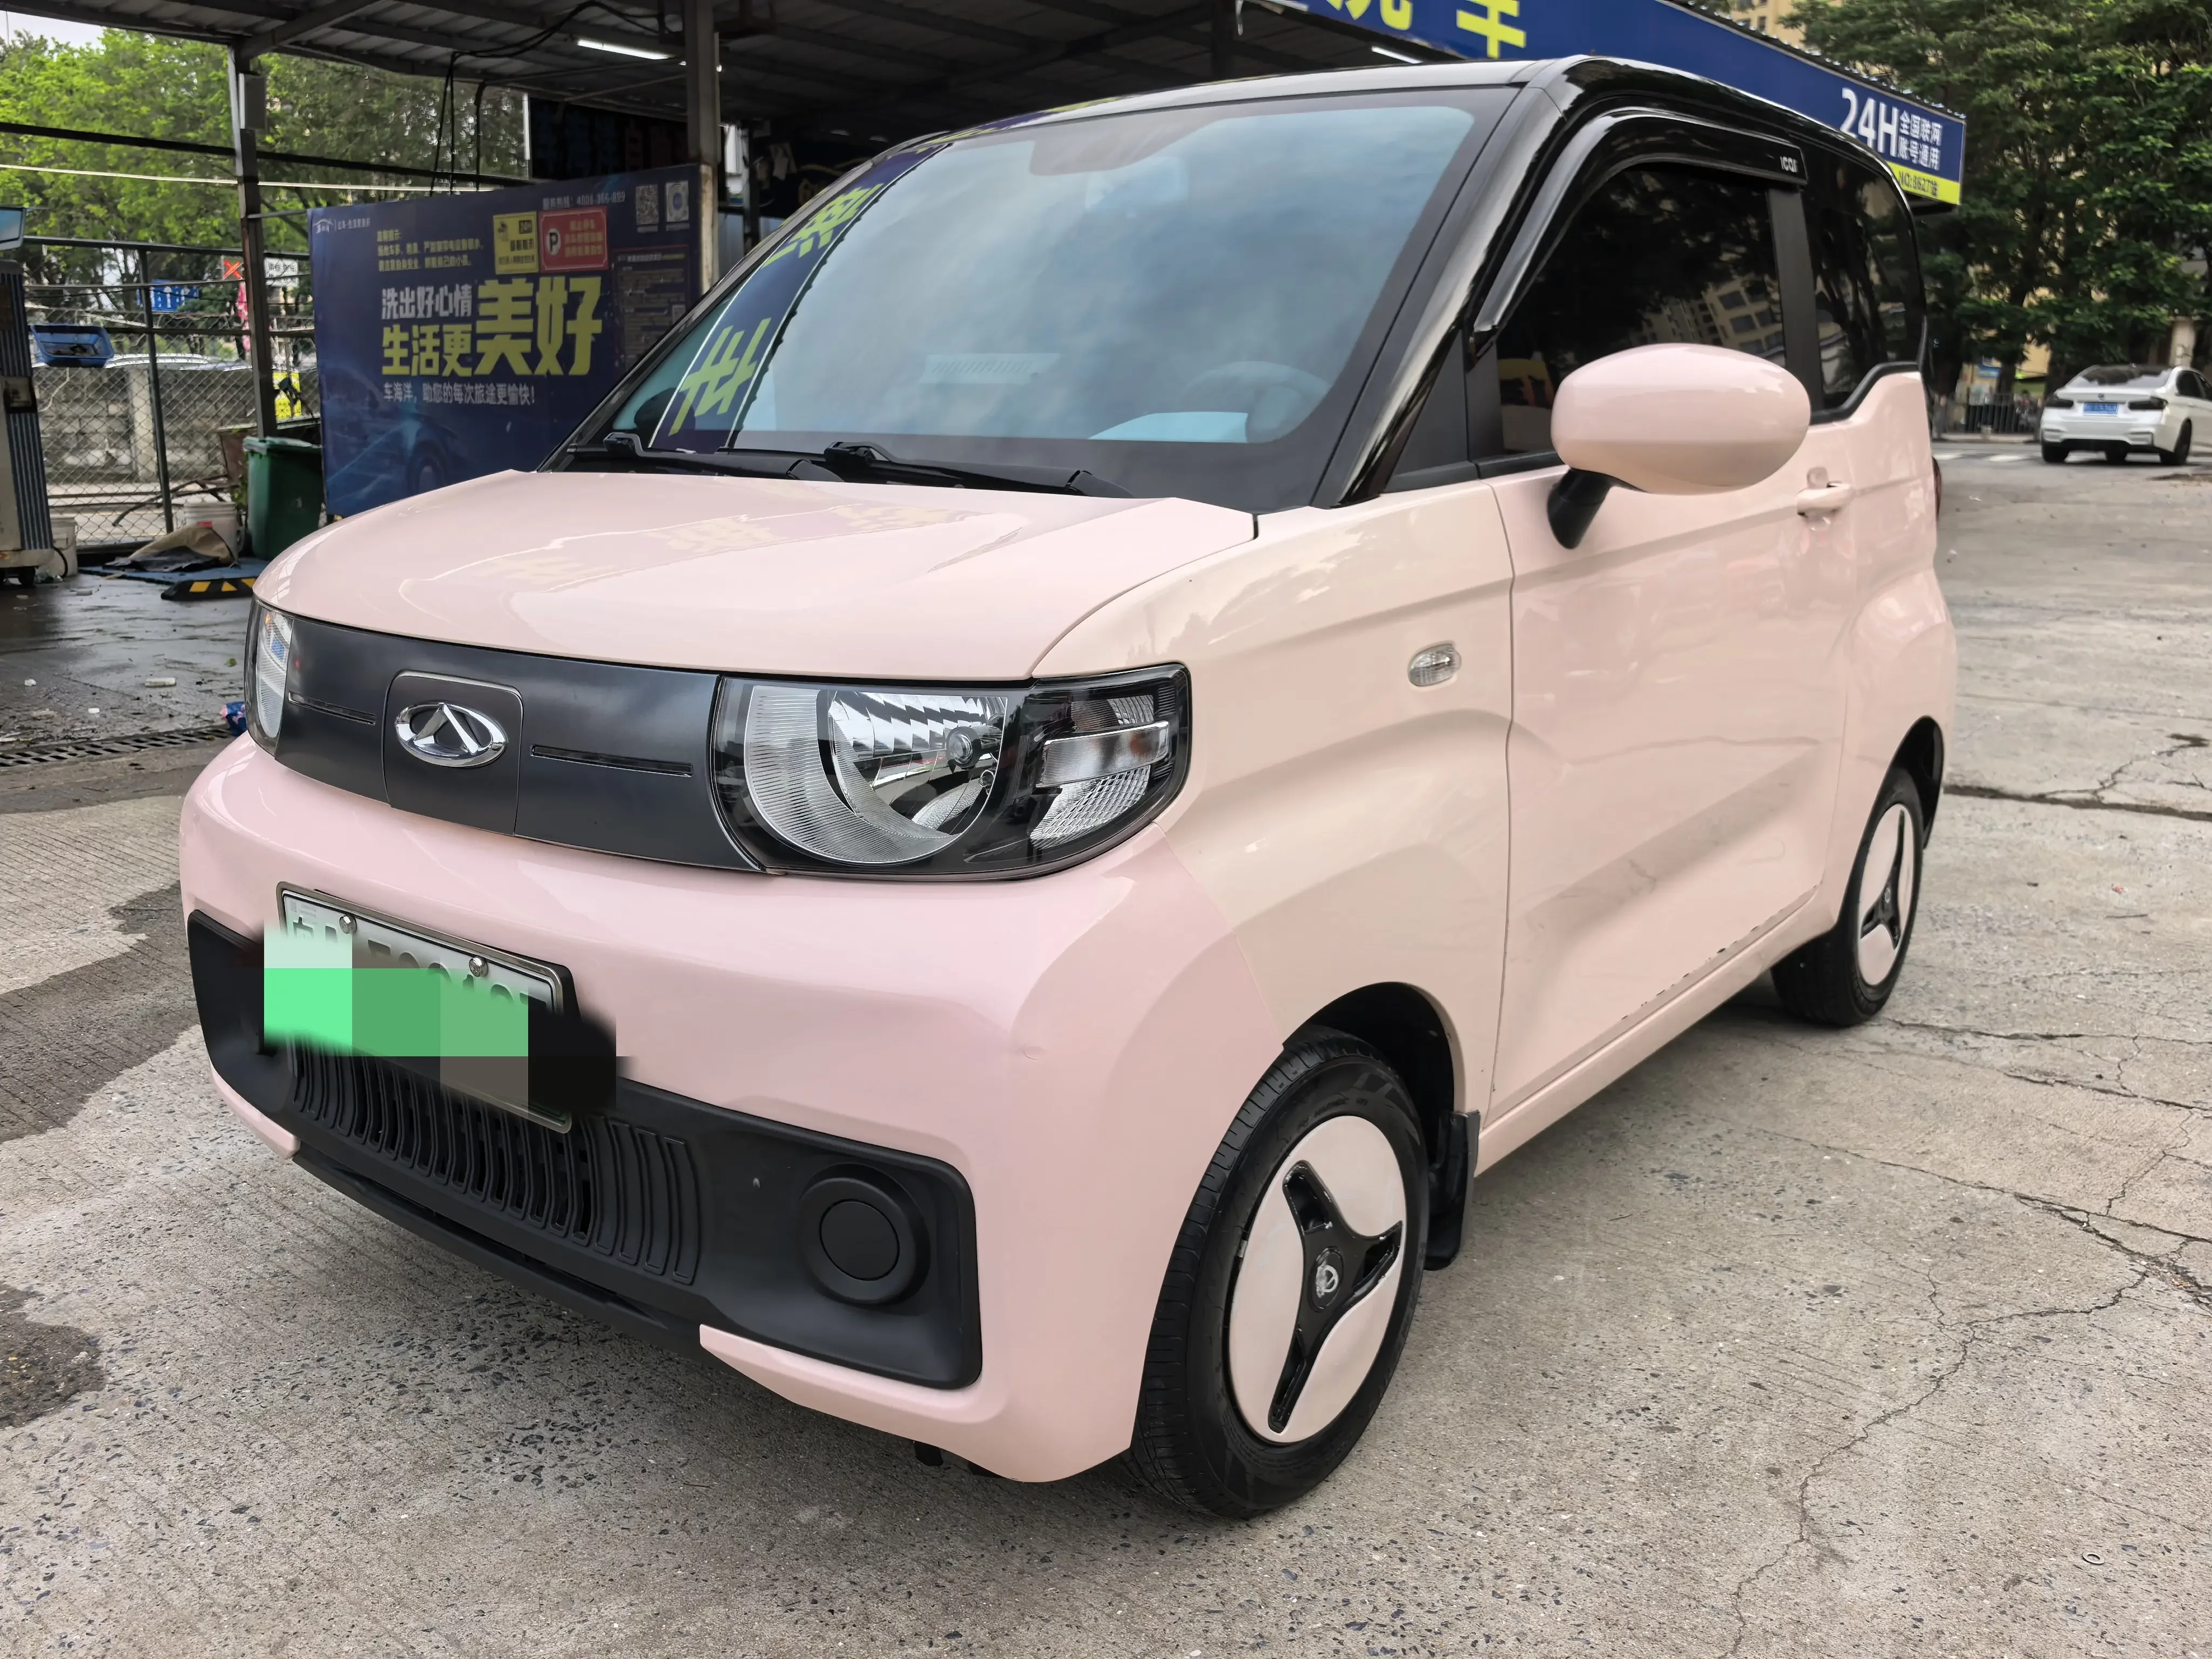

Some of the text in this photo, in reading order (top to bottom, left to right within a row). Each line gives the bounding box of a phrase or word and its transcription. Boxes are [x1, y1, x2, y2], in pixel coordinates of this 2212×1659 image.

[1839, 87, 1898, 157] 24H
[1899, 110, 1943, 146] 全国联网
[1897, 136, 1940, 171] 账号通用
[549, 232, 558, 252] P
[381, 282, 473, 320] 洗出好心情
[474, 276, 603, 376] 美好
[381, 324, 472, 377] 生活更
